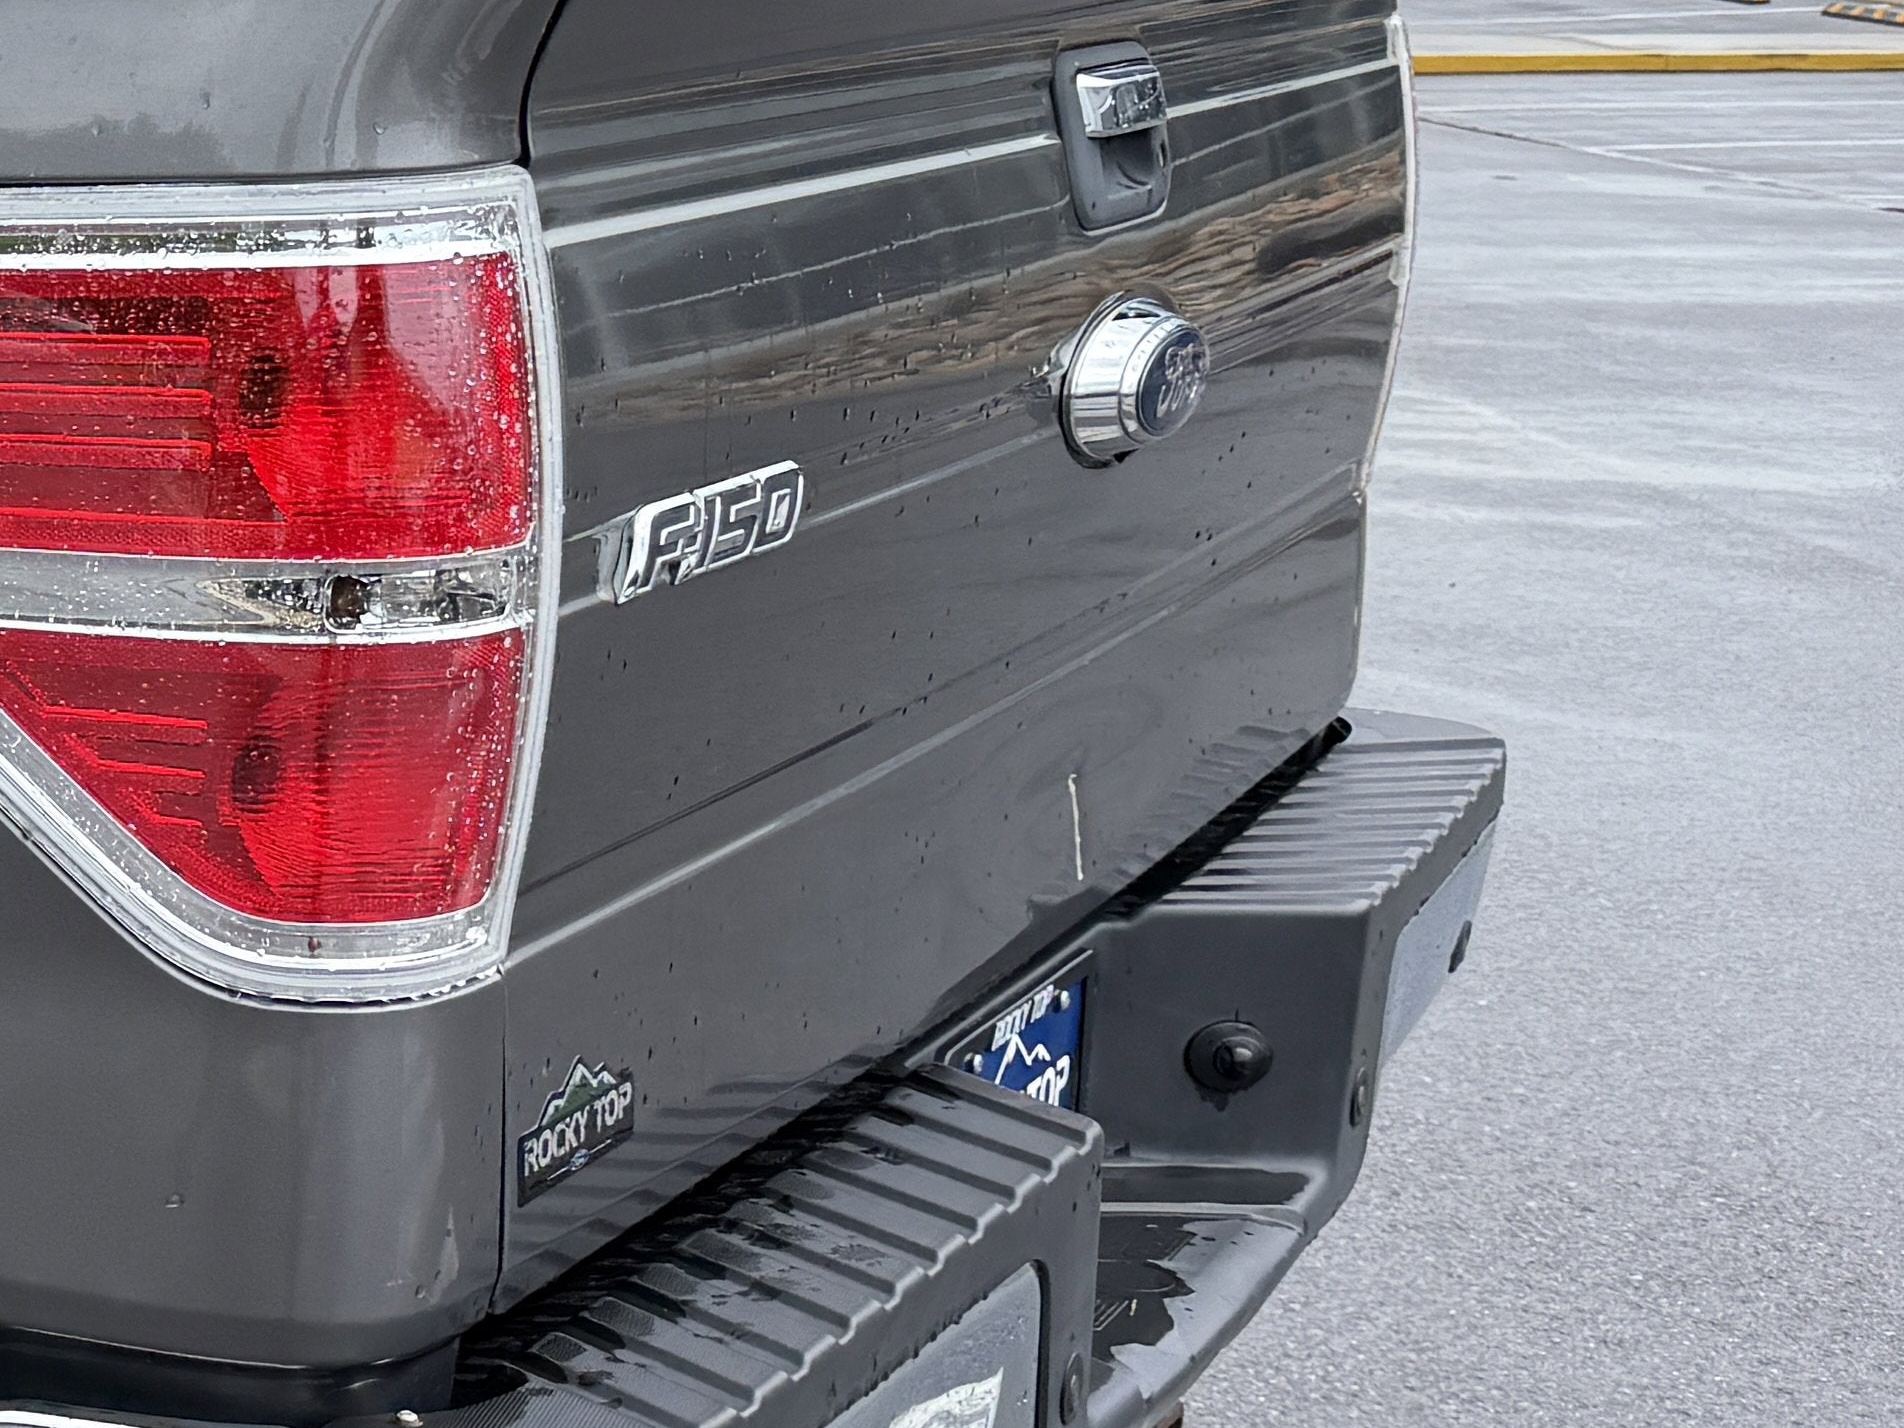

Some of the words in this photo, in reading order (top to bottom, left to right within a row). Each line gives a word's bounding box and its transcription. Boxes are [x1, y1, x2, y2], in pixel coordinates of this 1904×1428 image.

[616, 459, 804, 605] F-150
[523, 1104, 591, 1177] ROCKY
[592, 1081, 632, 1134] TOP
